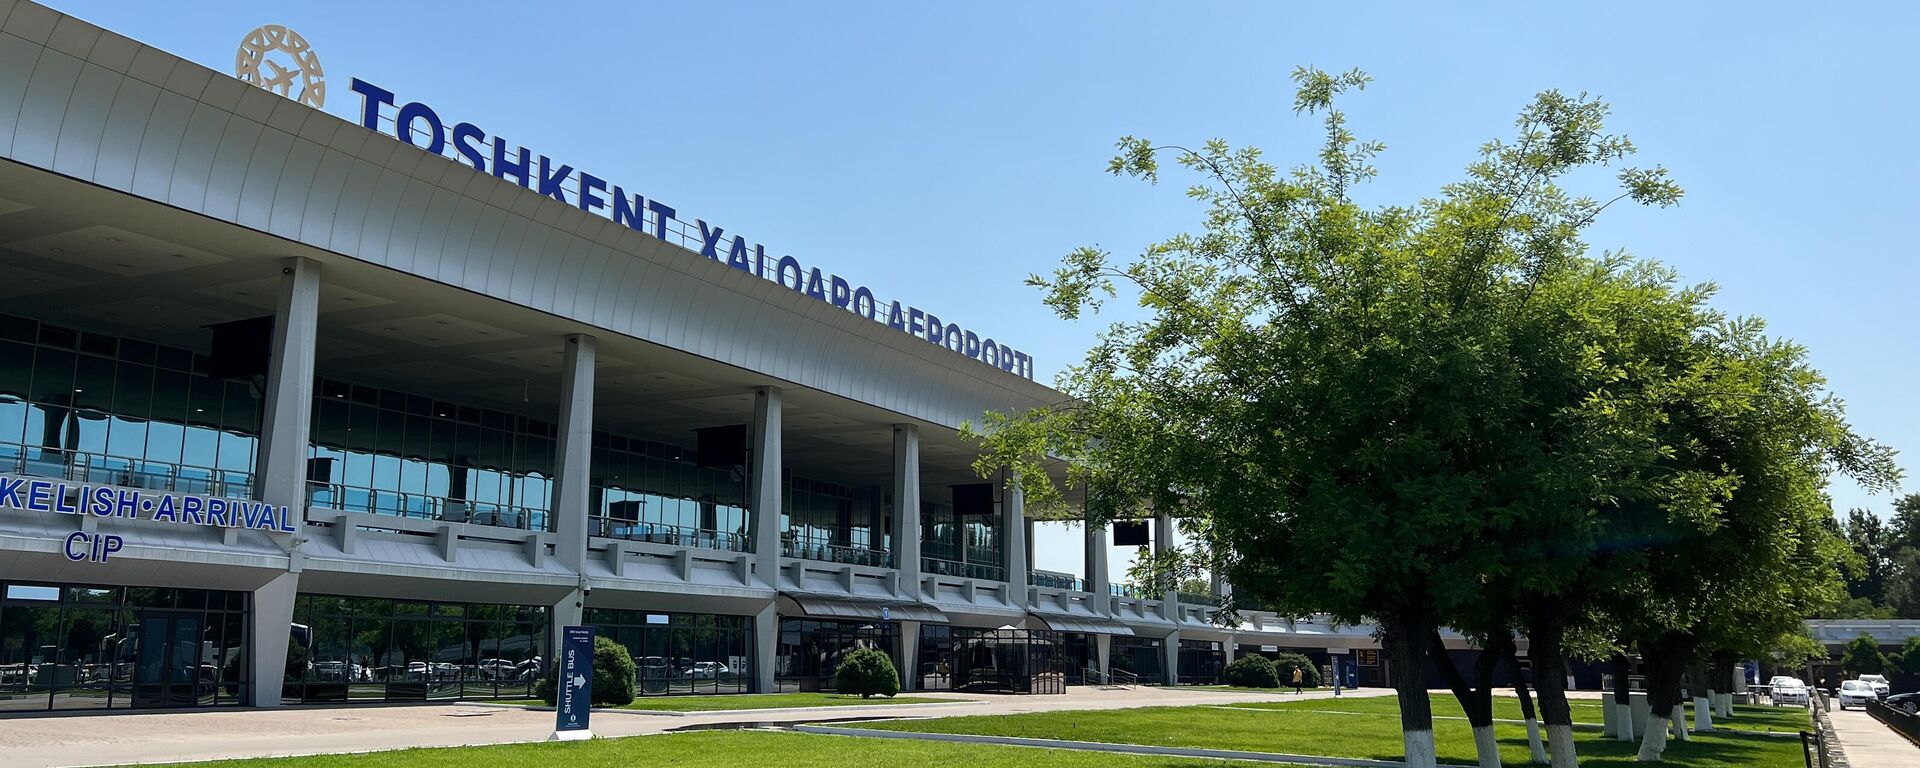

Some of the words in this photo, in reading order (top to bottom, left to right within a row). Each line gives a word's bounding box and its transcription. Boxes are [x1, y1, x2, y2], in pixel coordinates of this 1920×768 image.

[349, 76, 677, 241] TOSHKENT
[64, 530, 124, 564] CIP
[567, 649, 575, 669] BUS
[564, 672, 574, 714] SHUTTLE
